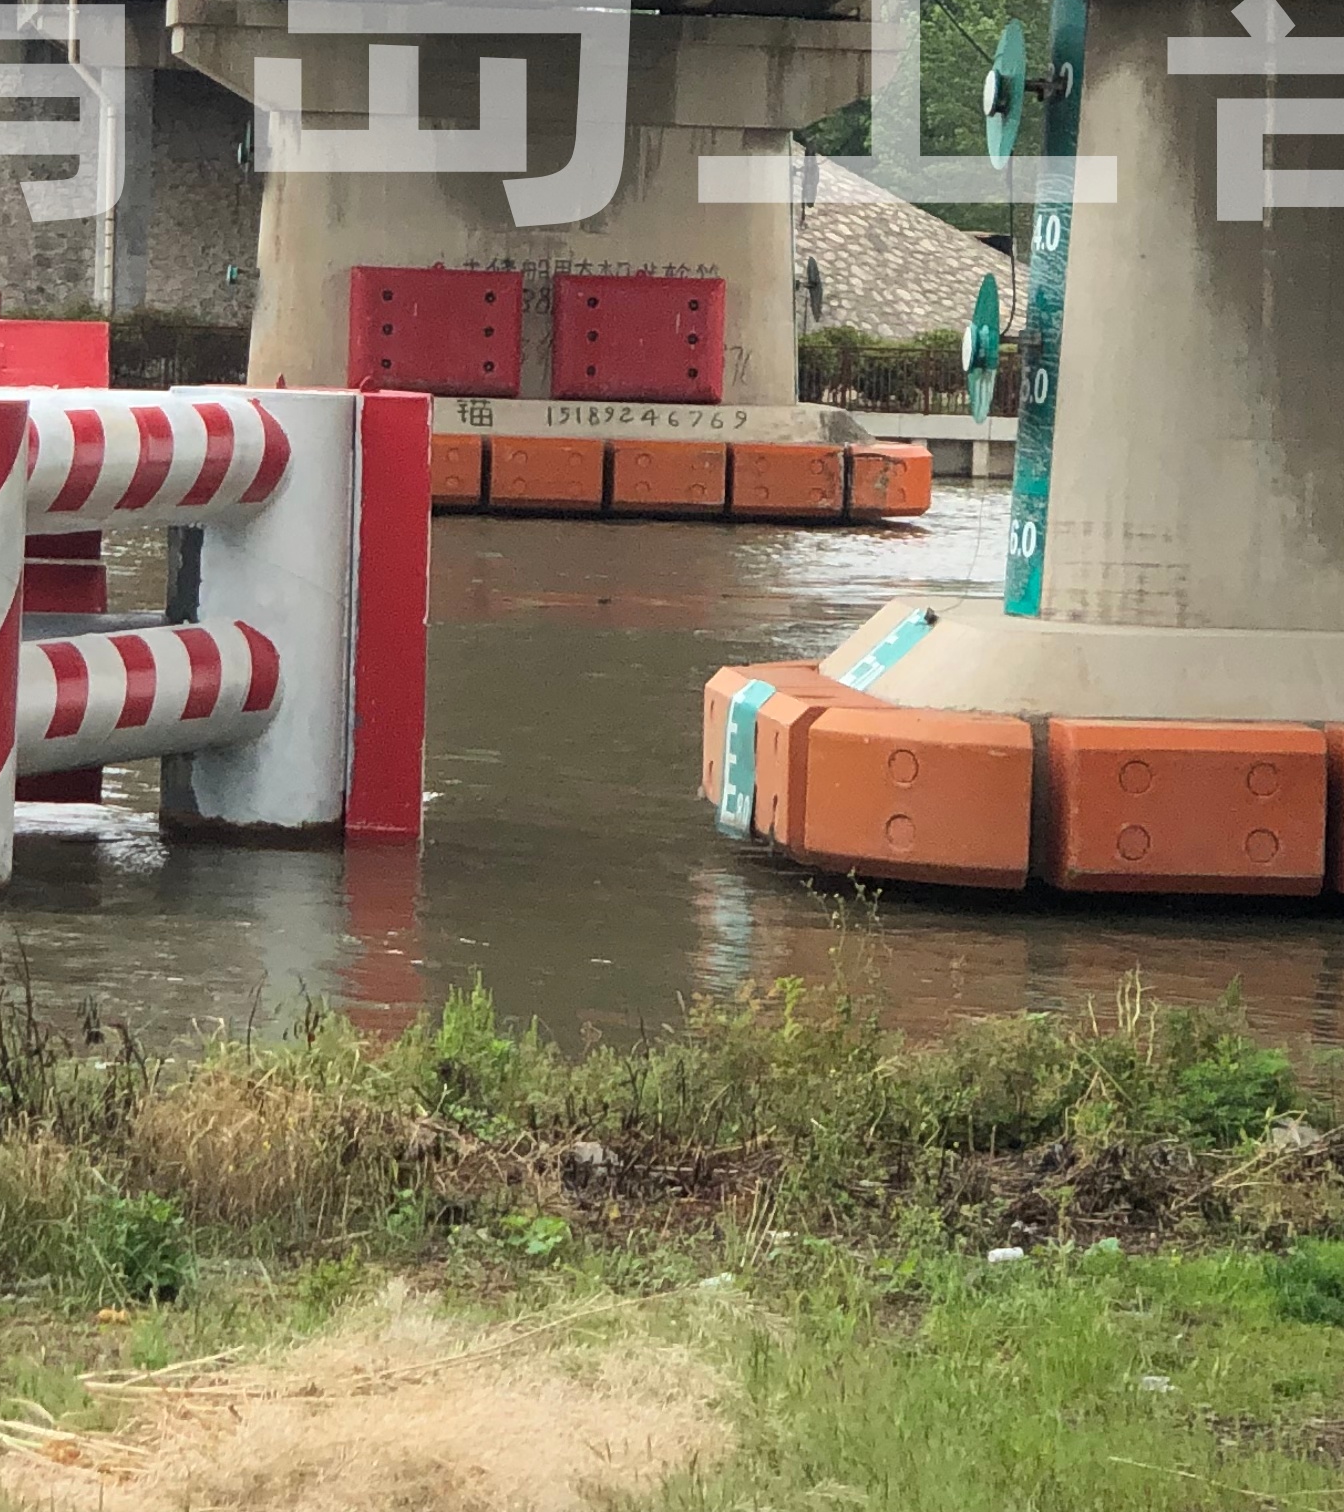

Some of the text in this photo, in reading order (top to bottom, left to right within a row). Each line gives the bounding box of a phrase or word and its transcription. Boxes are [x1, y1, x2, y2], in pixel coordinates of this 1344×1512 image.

[1033, 214, 1060, 251] 4.0
[1020, 367, 1049, 405] 5.0
[546, 405, 748, 430] 15189246769
[1010, 520, 1036, 557] 6.0
